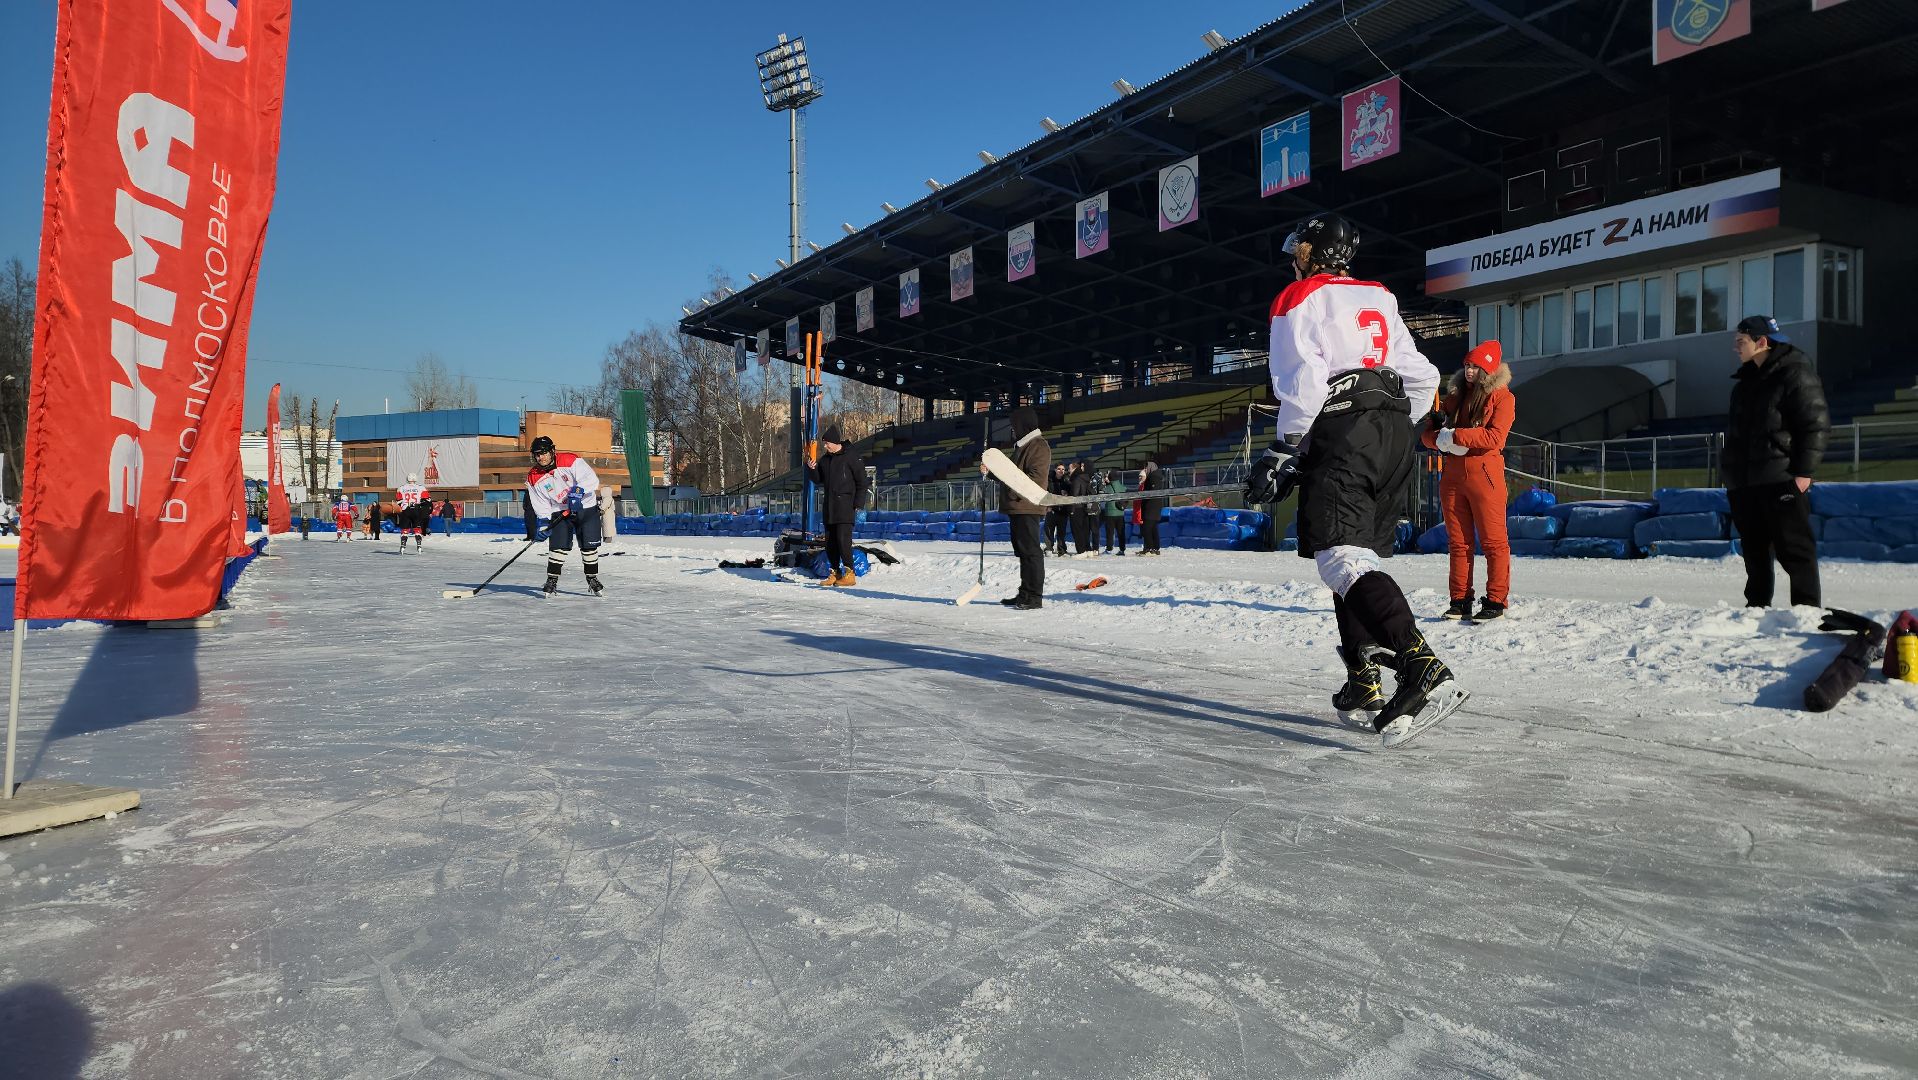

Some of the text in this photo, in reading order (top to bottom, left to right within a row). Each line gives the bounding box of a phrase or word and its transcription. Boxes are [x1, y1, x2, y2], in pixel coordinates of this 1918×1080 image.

[1470, 242, 1535, 272] ПОБЕДА
[1538, 228, 1596, 257] БУДЕТ
[1648, 202, 1710, 234] НАМИ
[108, 92, 196, 518] ЗИМА
[1355, 307, 1390, 369] 3
